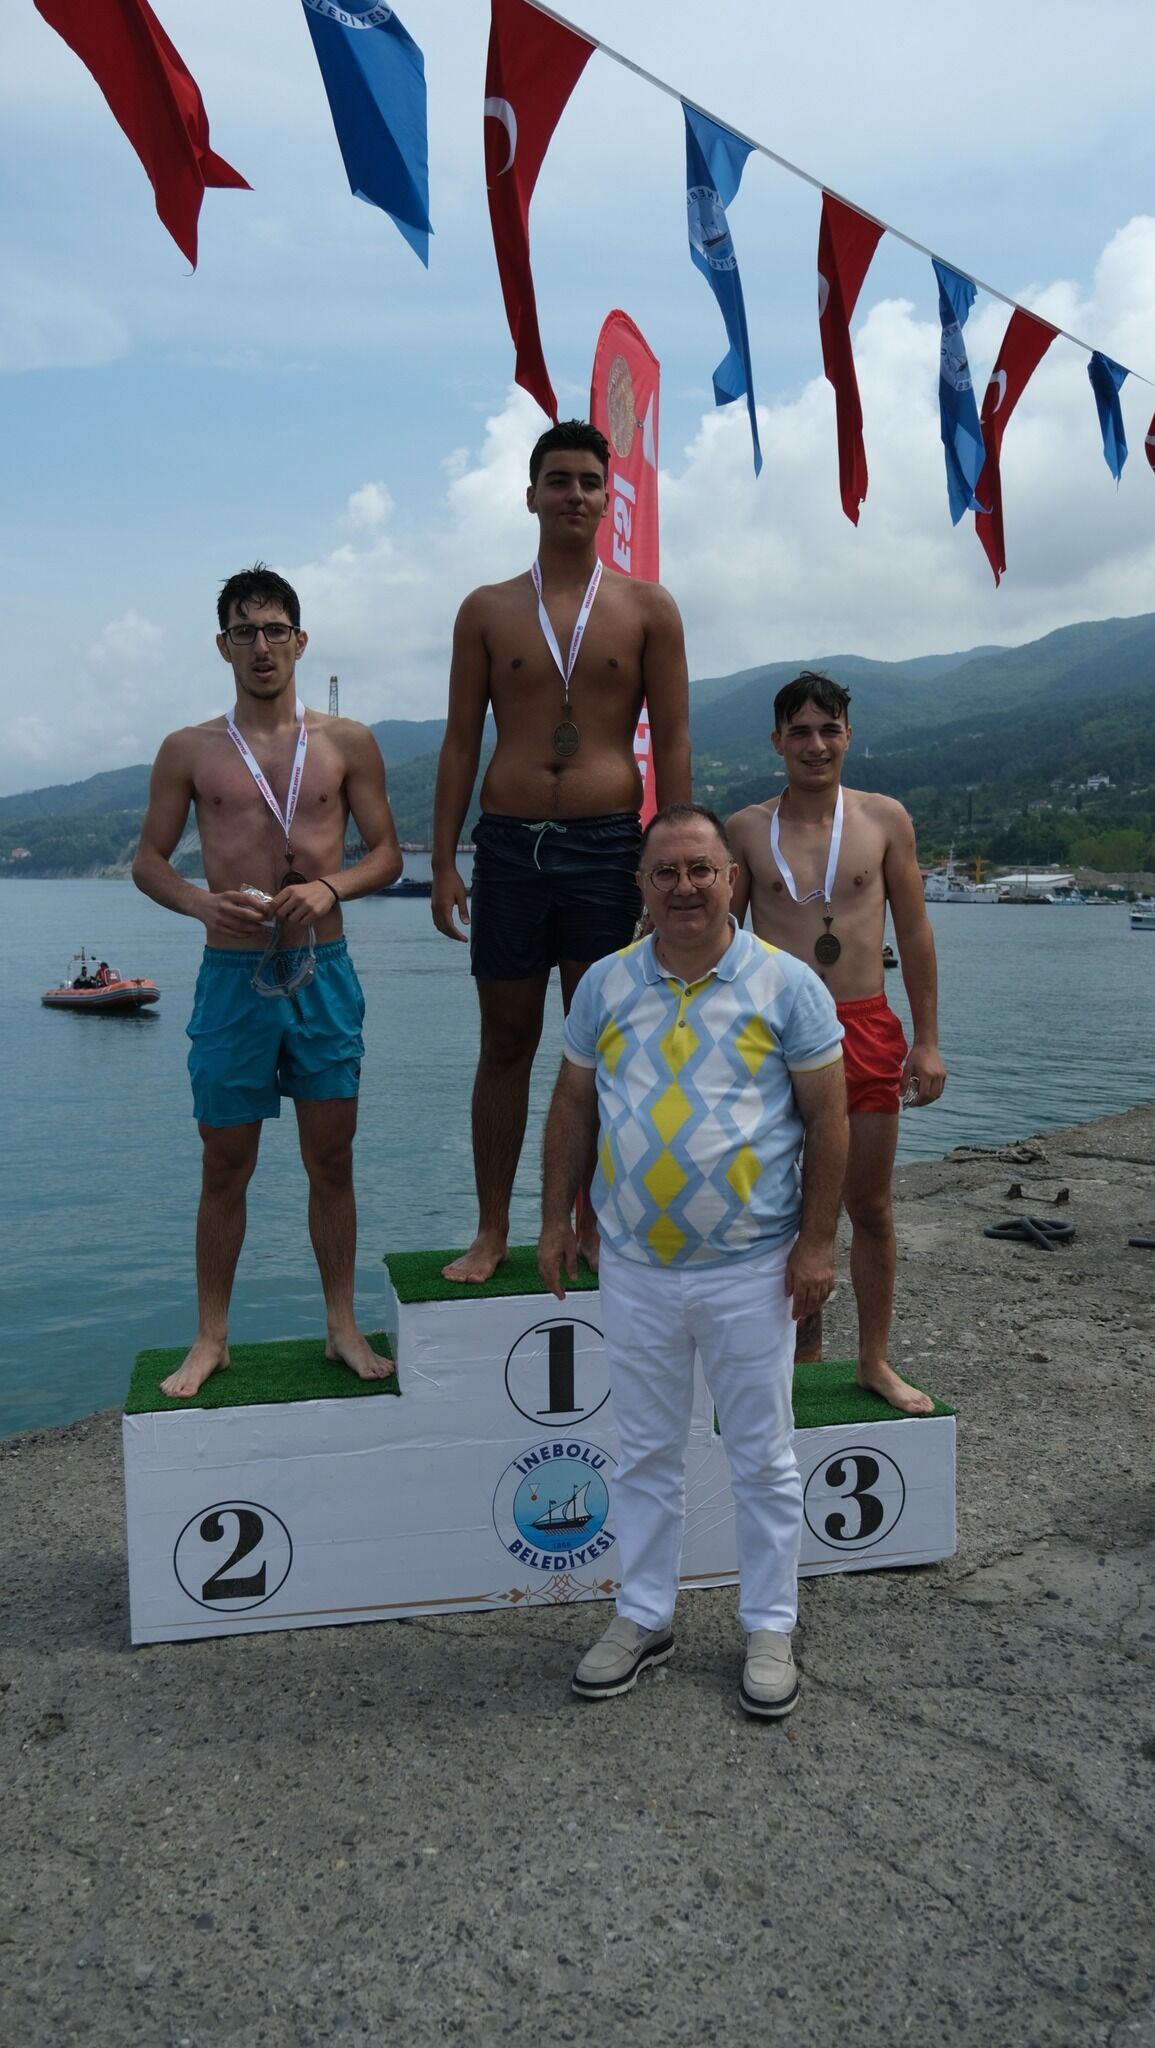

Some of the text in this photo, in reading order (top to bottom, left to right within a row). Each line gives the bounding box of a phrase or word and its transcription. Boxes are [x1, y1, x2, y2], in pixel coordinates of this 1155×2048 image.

[535, 1325, 584, 1414] 1
[513, 1444, 606, 1475] İNEBOLU
[825, 1455, 884, 1541] 3
[200, 1508, 266, 1600] 2
[508, 1528, 616, 1570] BELEDİYESİ
